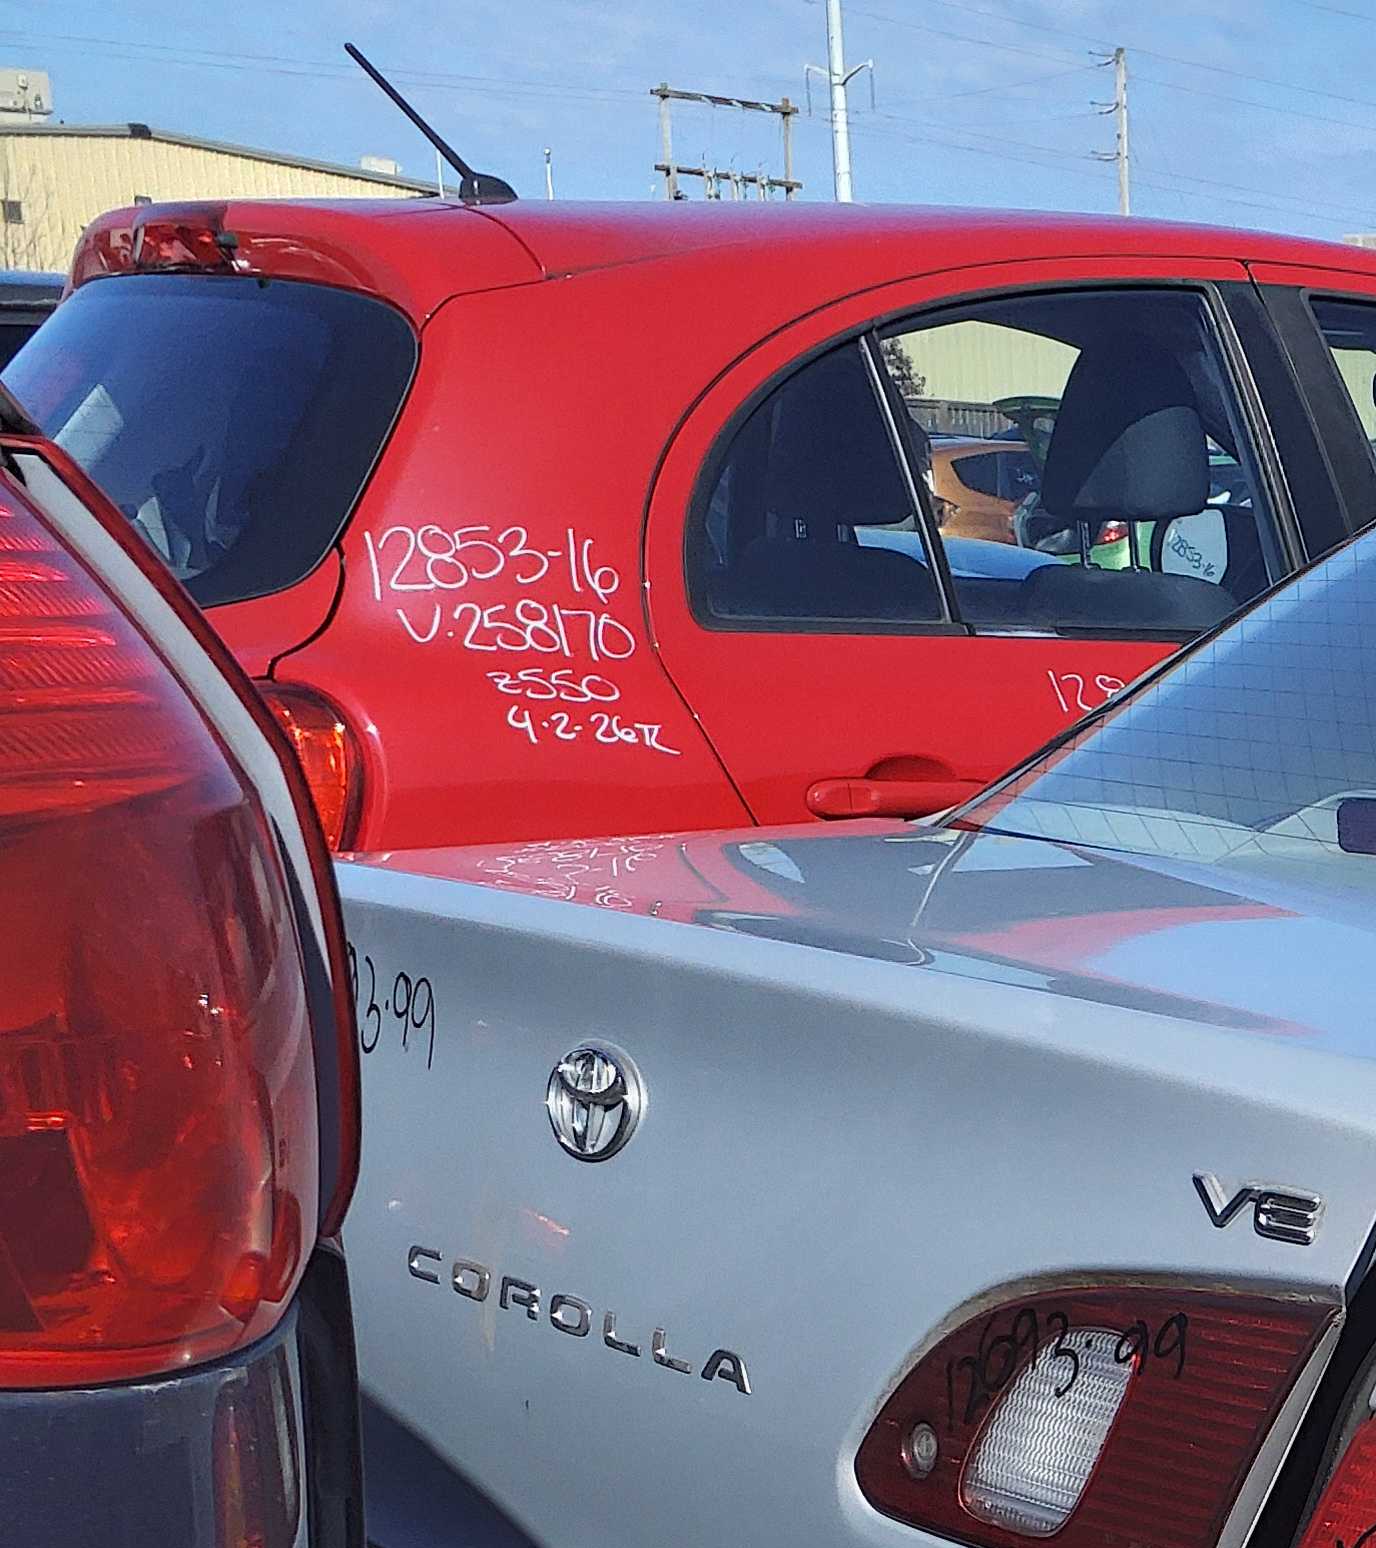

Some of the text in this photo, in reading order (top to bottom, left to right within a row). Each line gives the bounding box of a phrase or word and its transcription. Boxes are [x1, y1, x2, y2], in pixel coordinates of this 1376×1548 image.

[364, 525, 620, 603] 12853-16
[1192, 1168, 1327, 1246] VE
[408, 1245, 752, 1395] COROLLA
